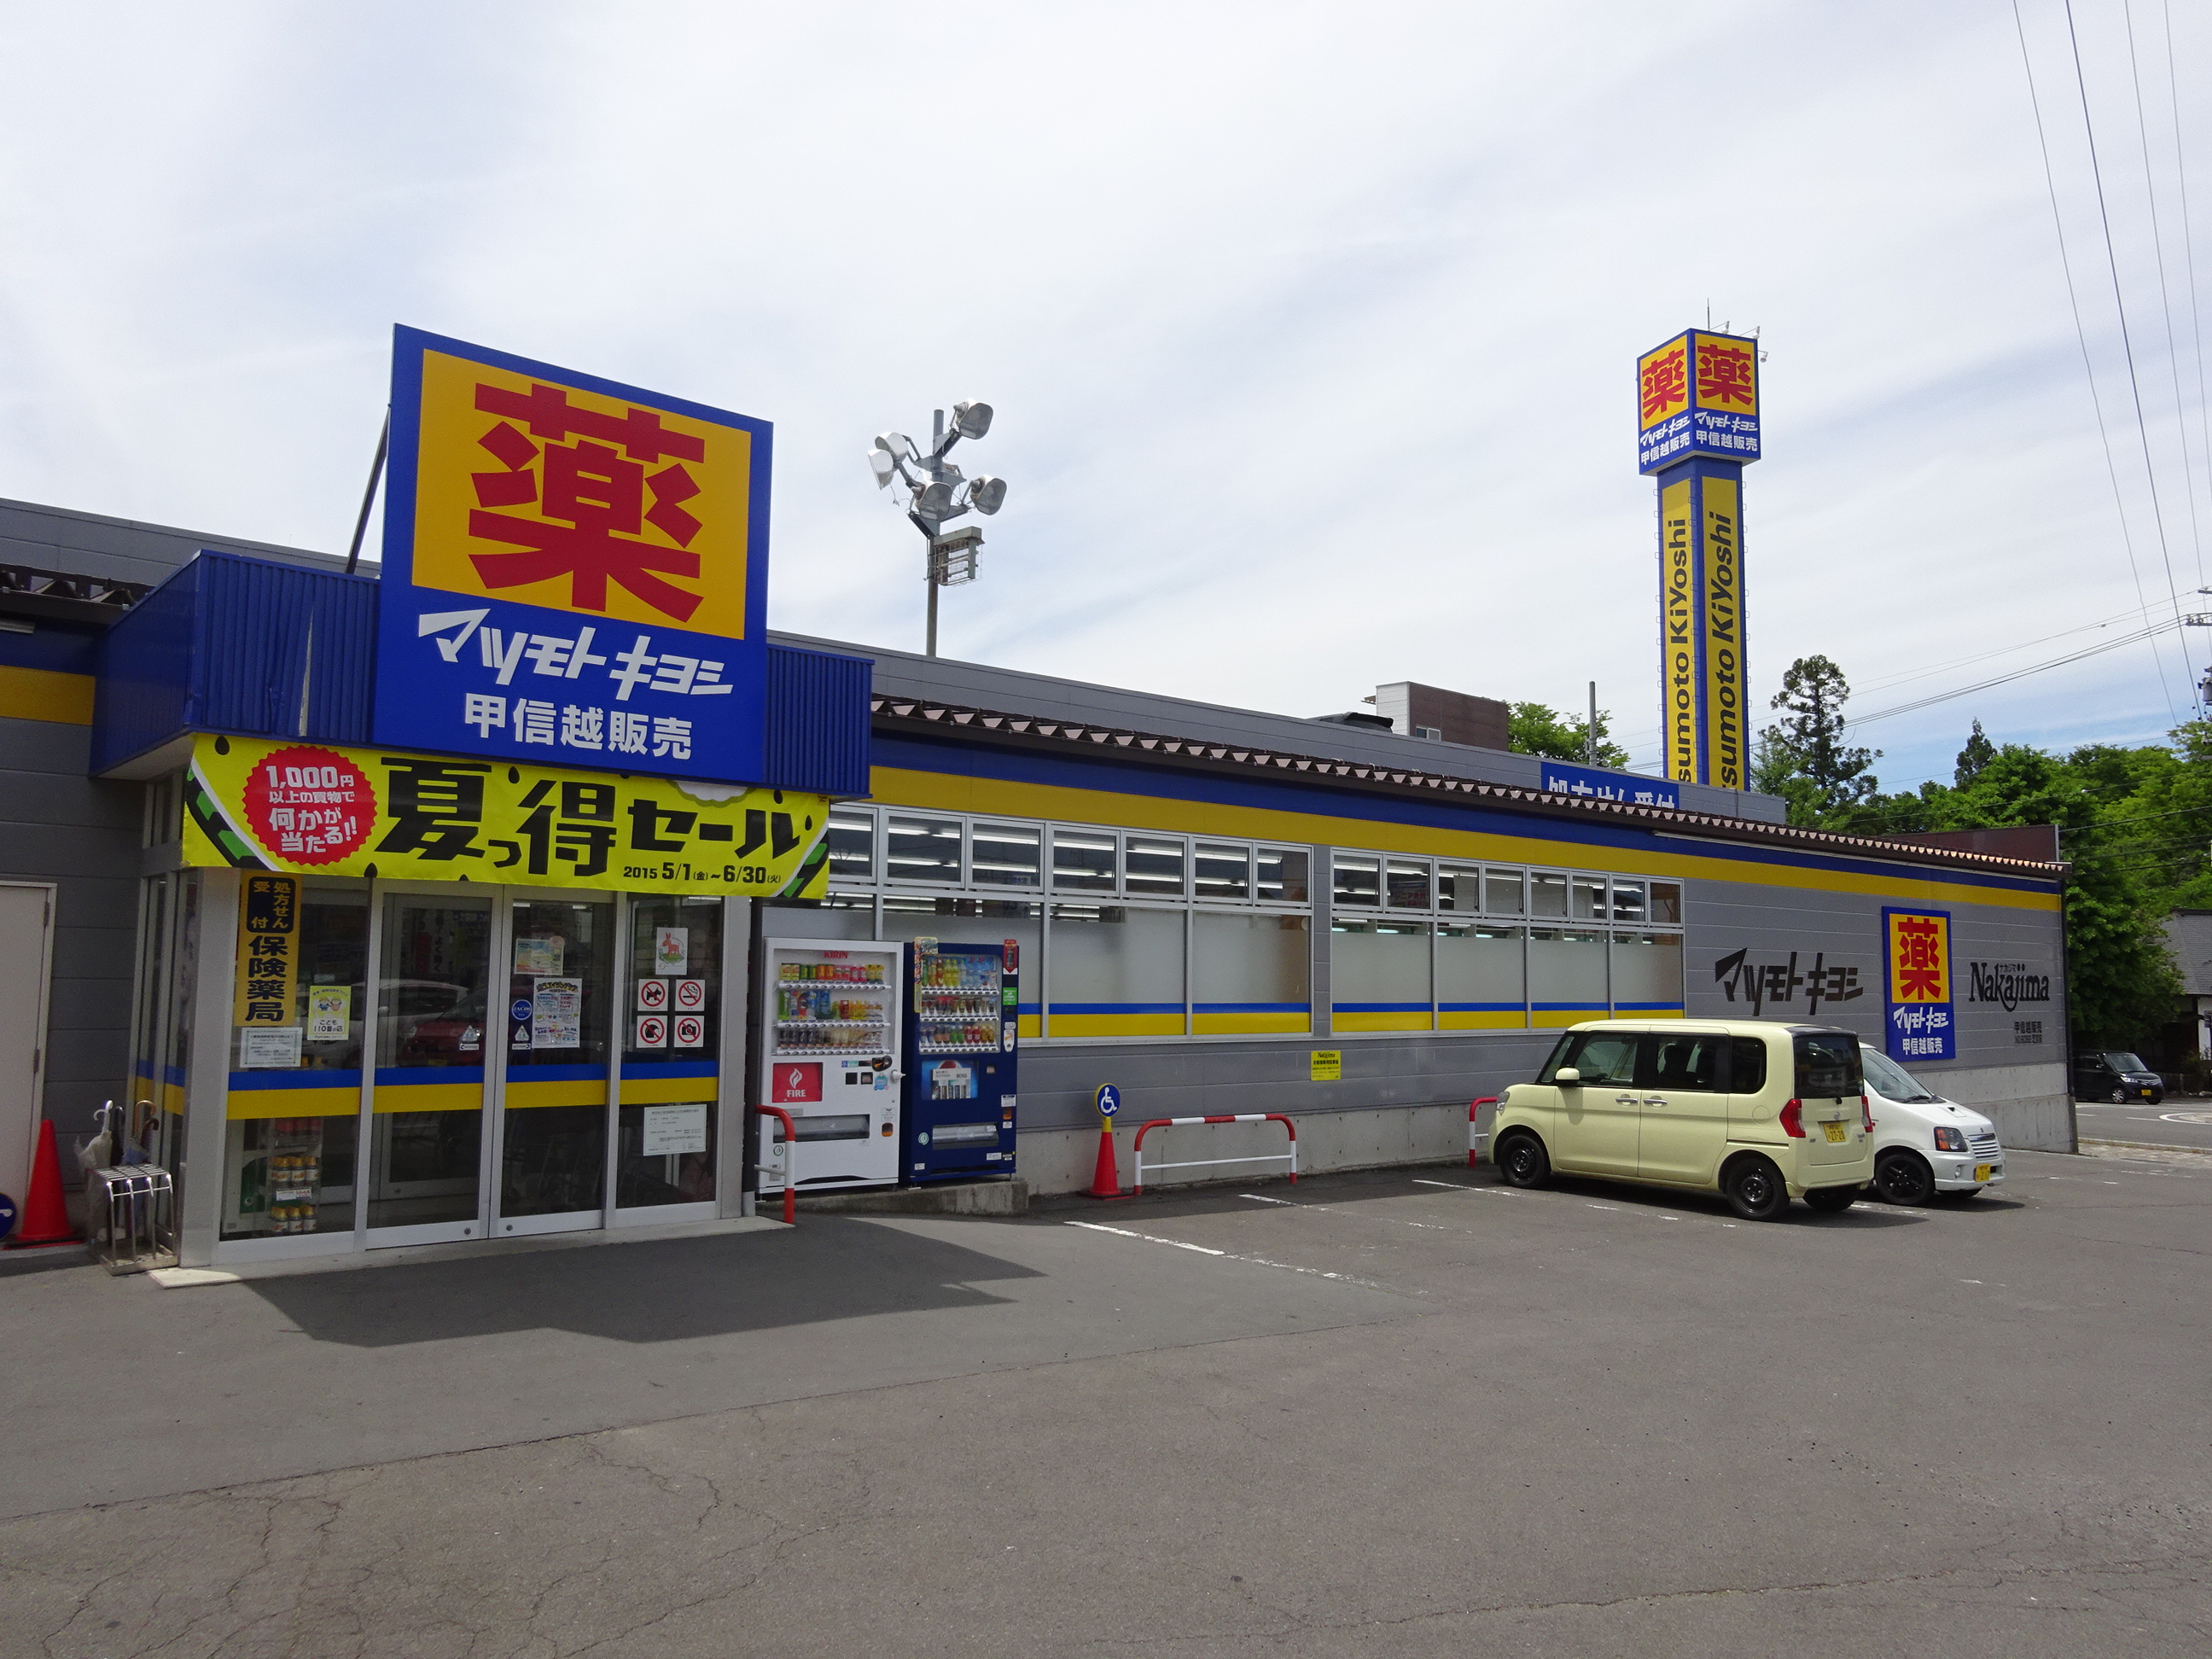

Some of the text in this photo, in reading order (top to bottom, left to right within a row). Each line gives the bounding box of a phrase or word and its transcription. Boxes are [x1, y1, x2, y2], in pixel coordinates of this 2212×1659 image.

[1642, 348, 1686, 420] 薬
[1697, 344, 1753, 406] 薬
[1641, 431, 1690, 465] 甲信越販売
[1696, 430, 1758, 451] 甲信越販売
[468, 381, 706, 623] 薬
[463, 692, 693, 760] 甲信越販売
[1715, 649, 1738, 788] sumoto
[265, 765, 355, 789] 1,000円
[268, 790, 355, 804] 以上の買物で
[268, 806, 342, 831] 何かが
[374, 756, 800, 876] 夏っ得セール
[623, 865, 658, 879] 2015
[272, 881, 291, 929] 処方せん
[244, 934, 288, 1022] 保険薬局
[824, 951, 848, 959] KIRIN
[1897, 917, 1941, 1001] 薬
[1968, 962, 2050, 1012] Nakajima
[1902, 1037, 1943, 1056] 甲信越販売
[786, 1089, 806, 1098] FIRE
